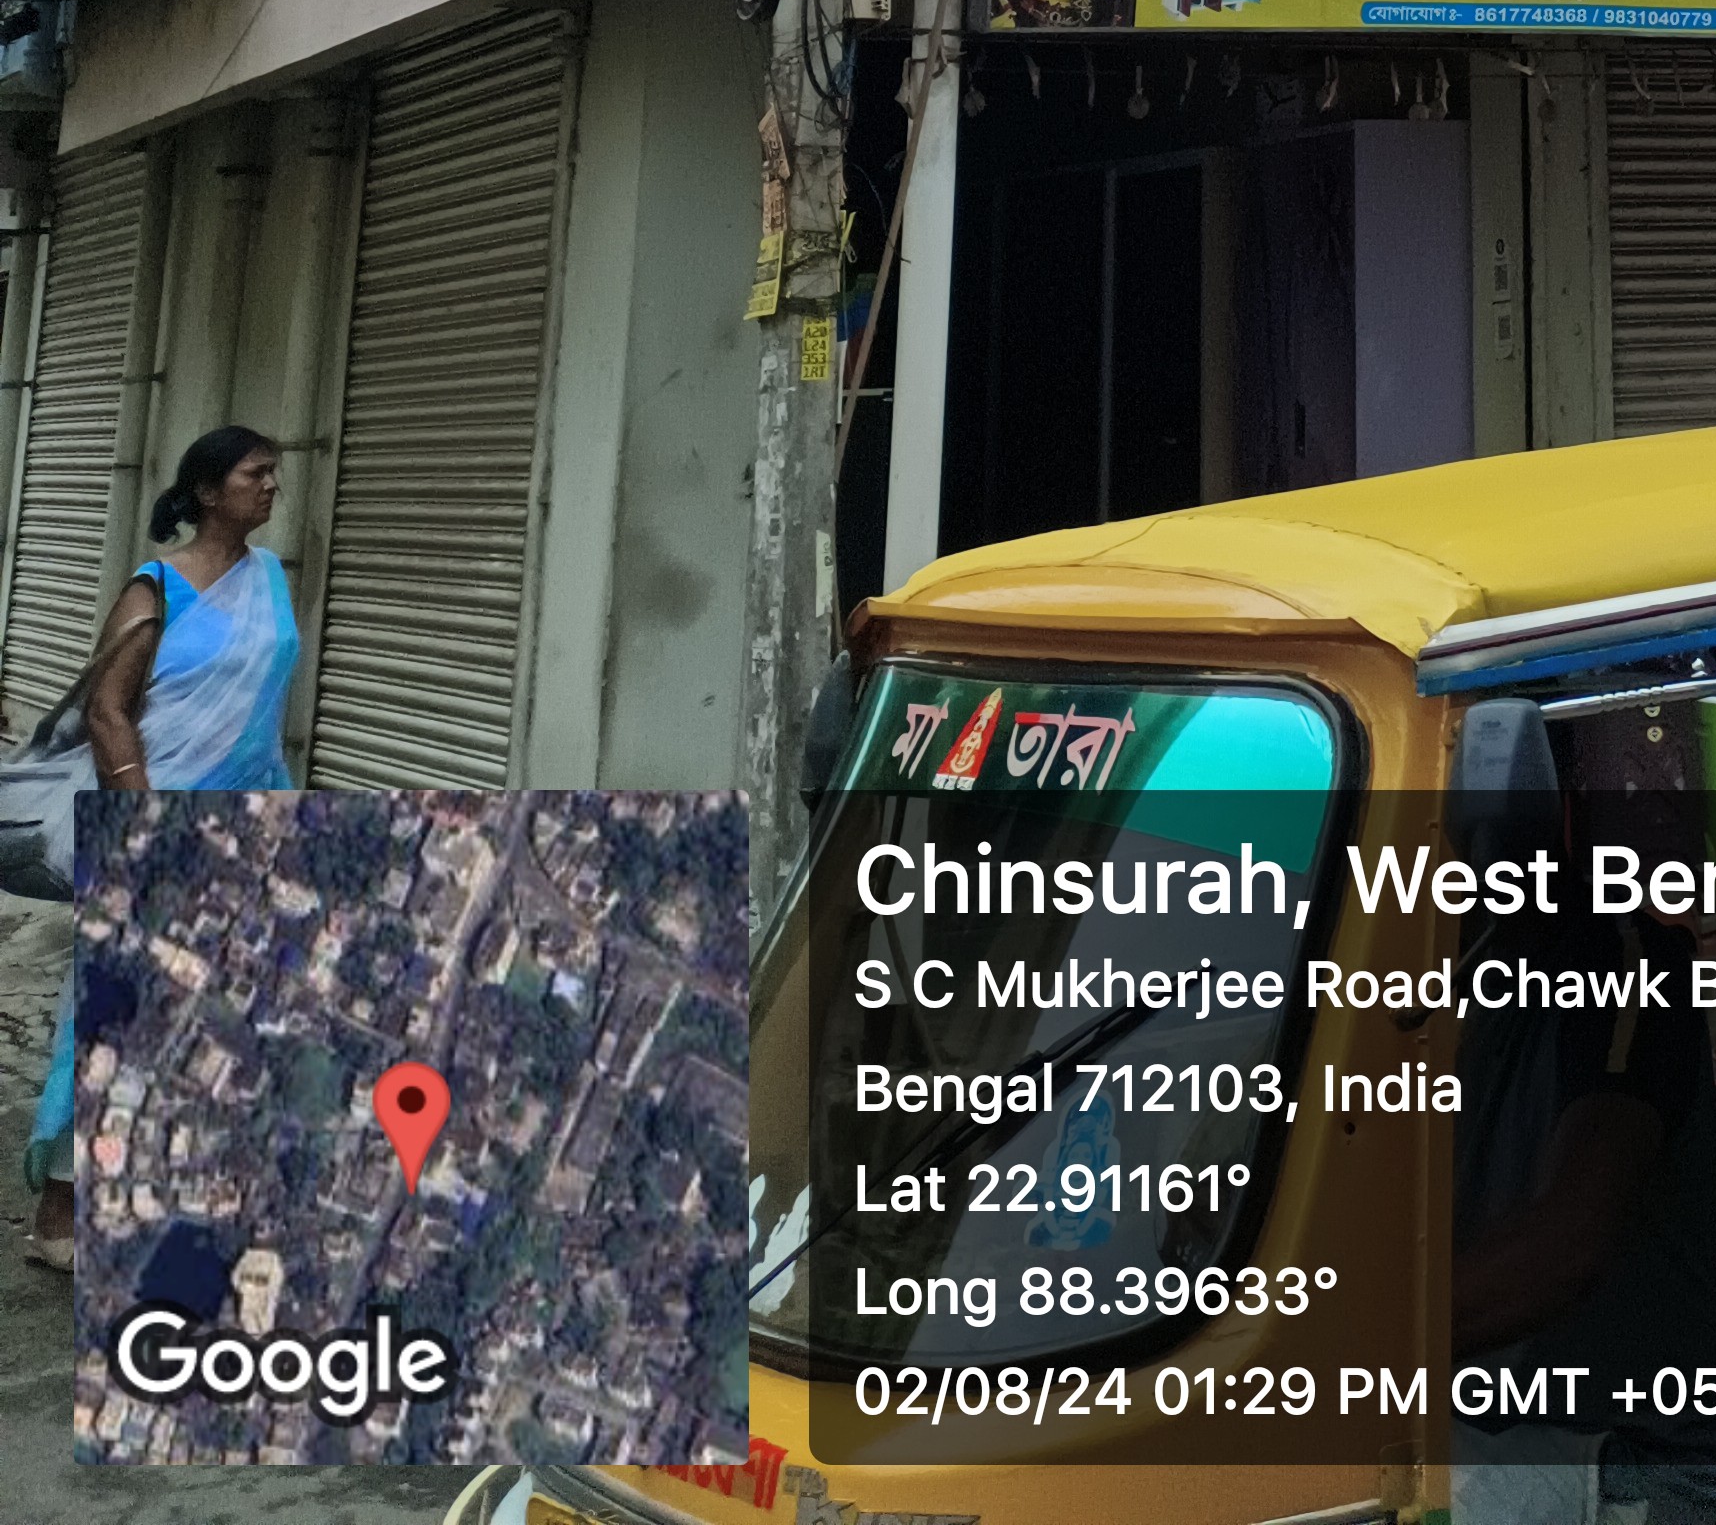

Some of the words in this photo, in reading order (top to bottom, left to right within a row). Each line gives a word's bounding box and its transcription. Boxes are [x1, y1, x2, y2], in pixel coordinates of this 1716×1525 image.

[1474, 7, 1588, 24] 8617748368
[1604, 9, 1713, 26] 9831040779
[891, 697, 949, 781] মা
[1006, 702, 1136, 793] তারা
